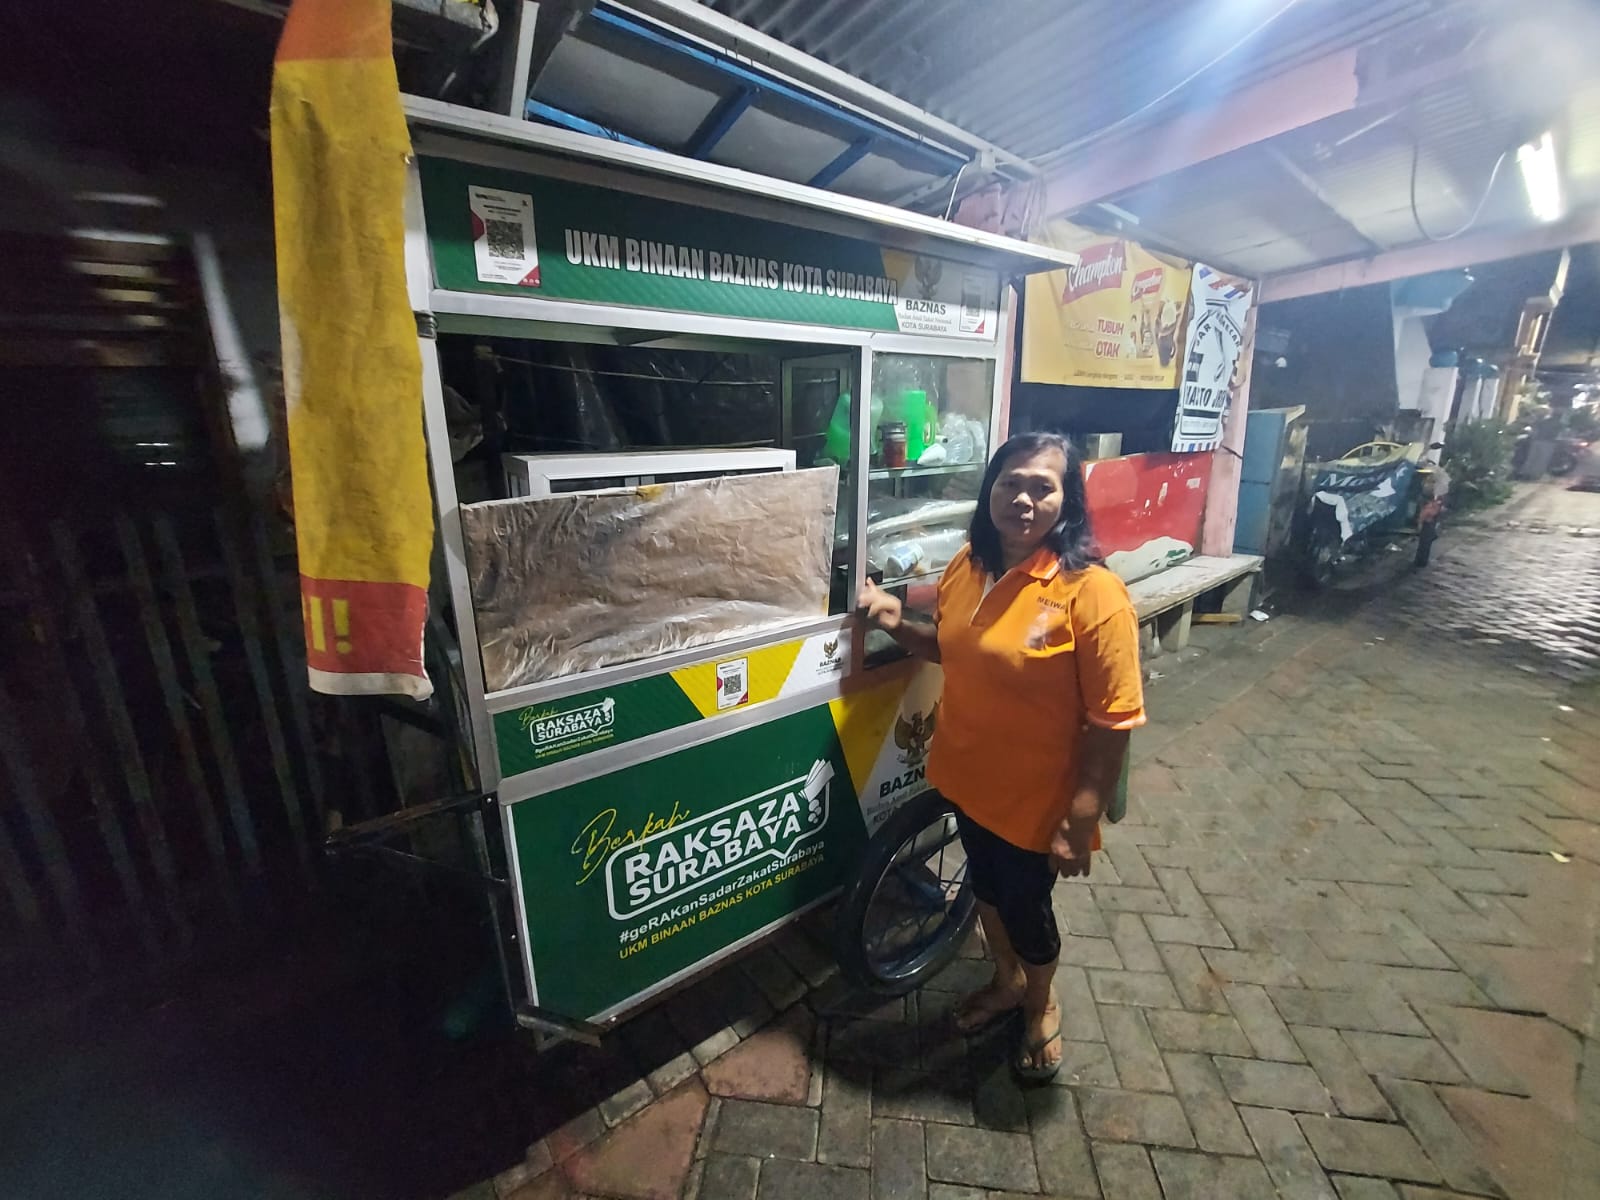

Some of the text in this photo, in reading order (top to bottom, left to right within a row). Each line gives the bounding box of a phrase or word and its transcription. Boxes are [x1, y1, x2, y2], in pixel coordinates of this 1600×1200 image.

[565, 228, 898, 305] UKM BINAAN BAZNAS KOTA SURABAYA
[906, 300, 946, 315] BAZNAS
[1097, 319, 1124, 335] TUBUH
[1096, 341, 1120, 357] OTAK
[536, 708, 602, 732] RAKSAZA
[538, 717, 602, 741] SURABAYA
[880, 765, 926, 798] BAZN
[571, 800, 690, 885] Berkah
[625, 792, 801, 884] RAKSAZA
[629, 815, 801, 906] SURABAYA
[619, 841, 825, 943] #geRAKanSadarZakatSurabaya
[619, 854, 824, 959] UKM BINAAN BAZNAS KOTA SURABAYA
